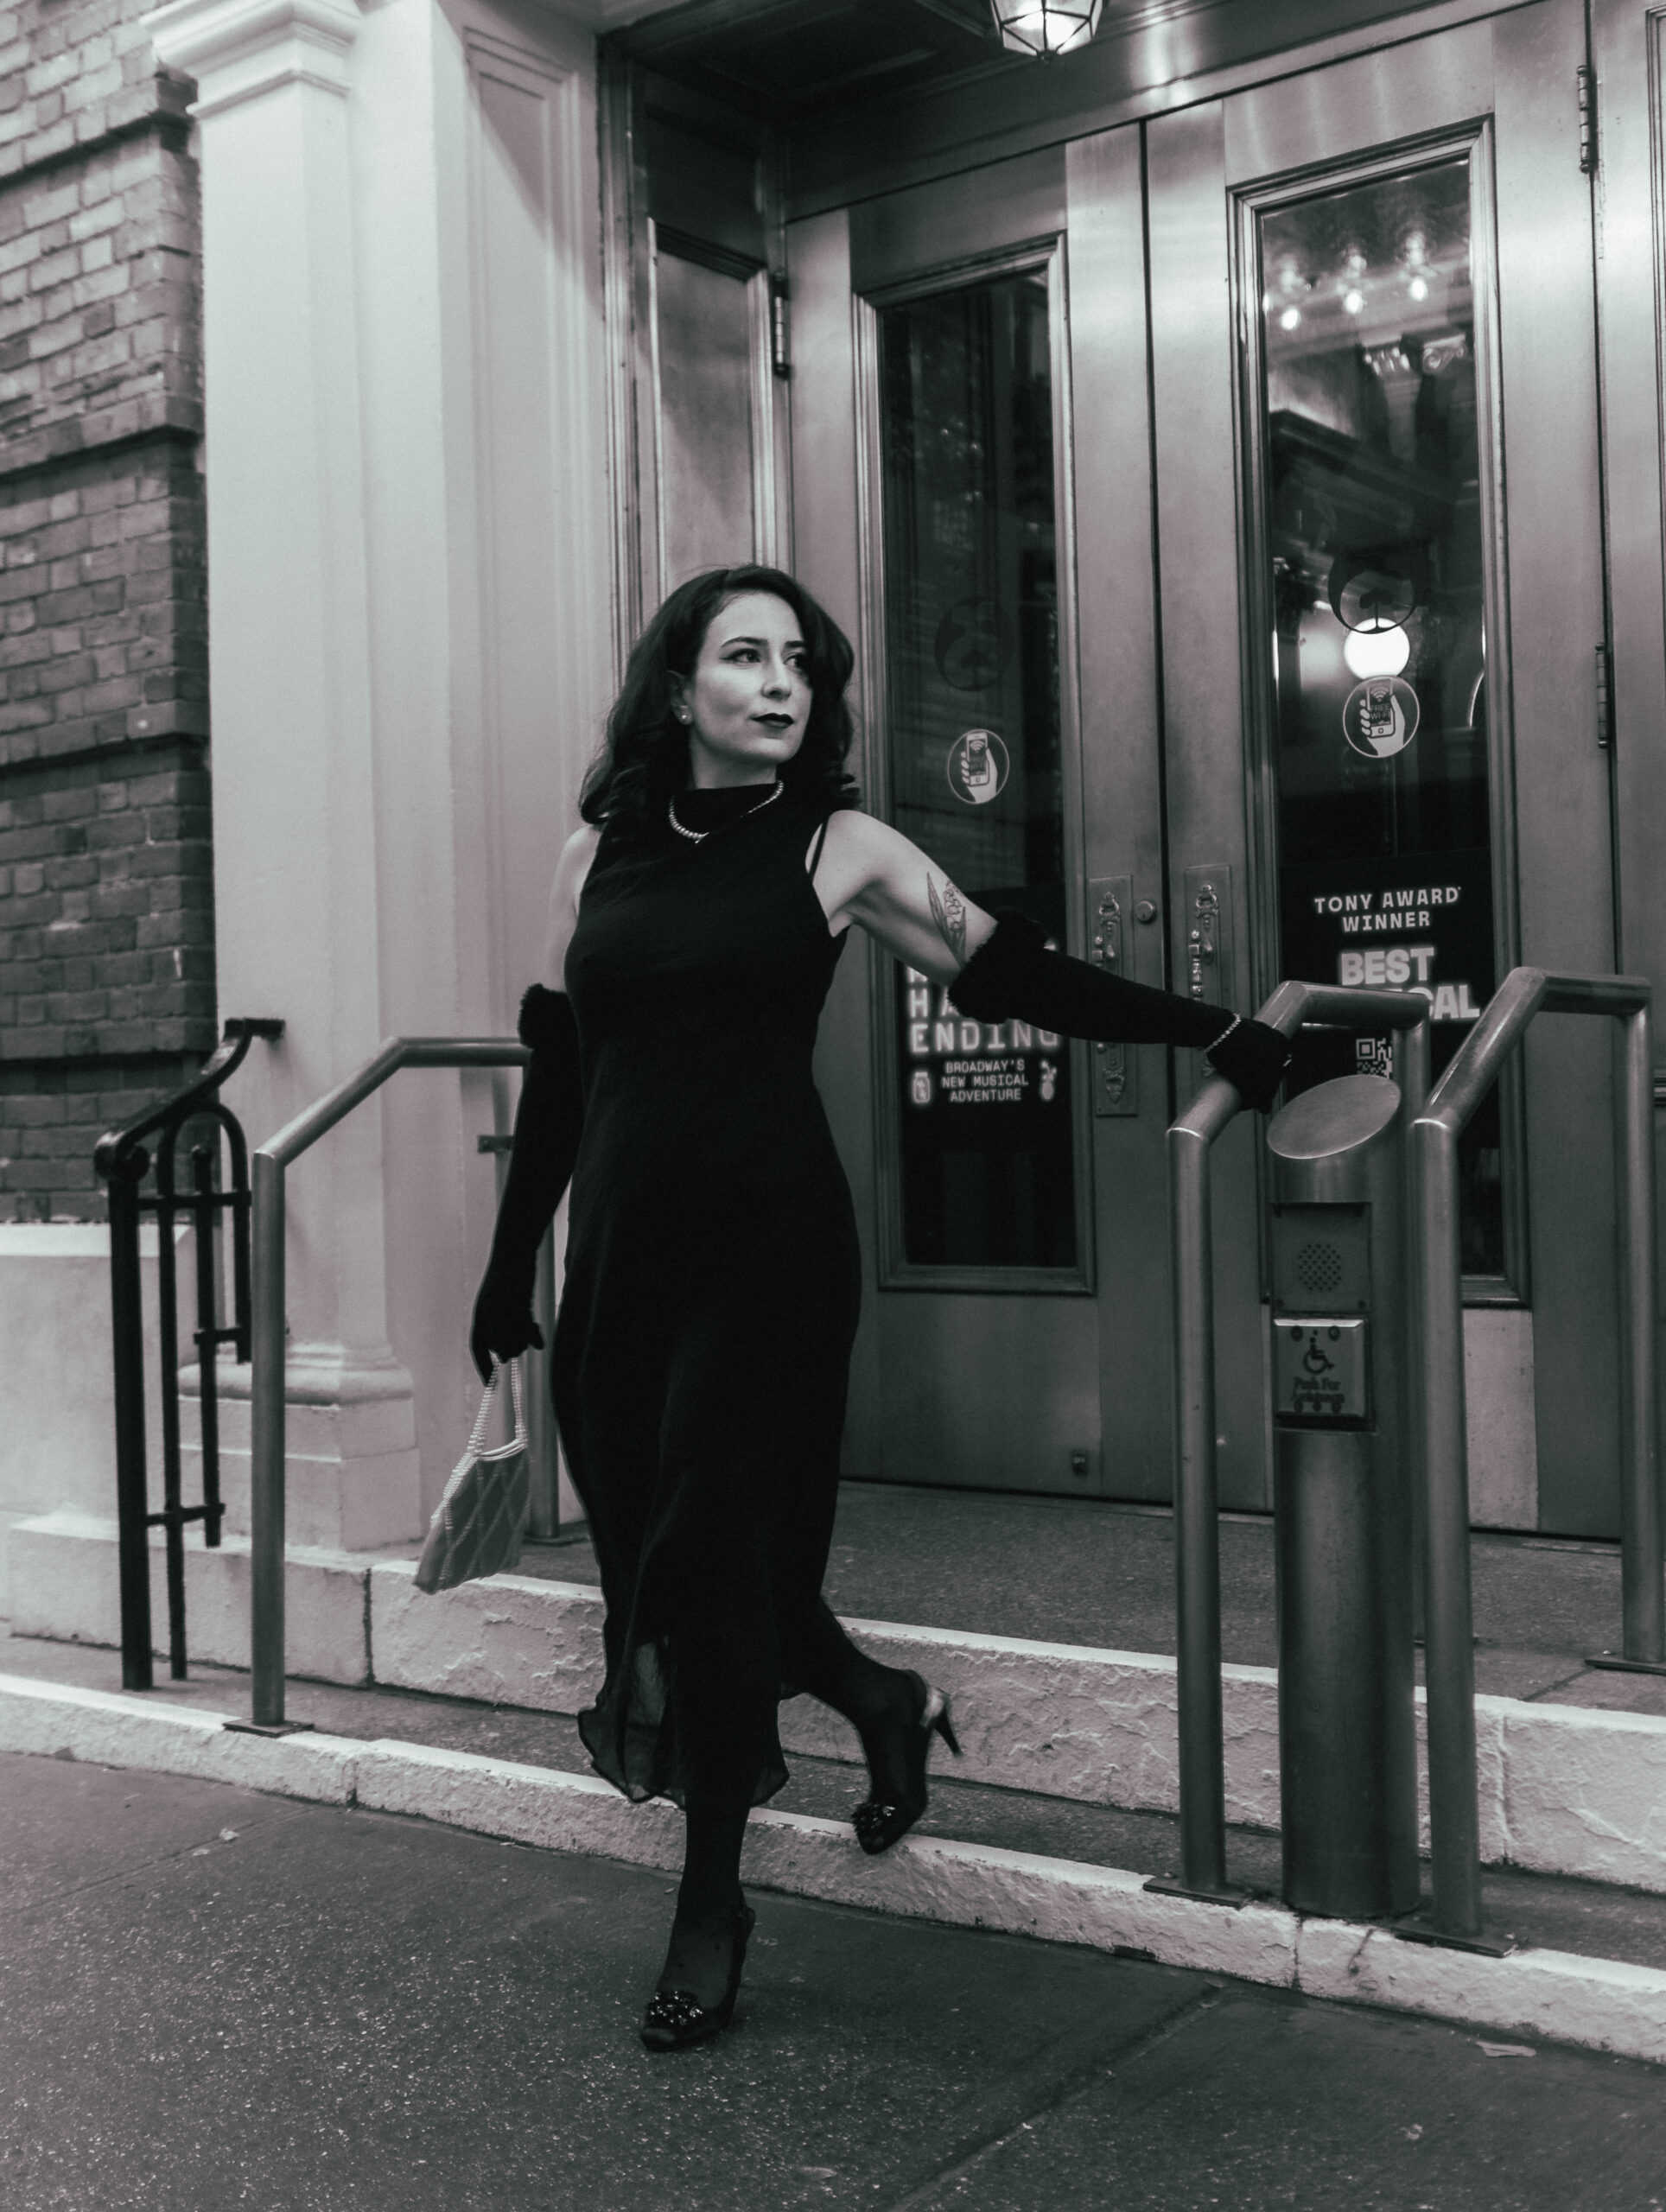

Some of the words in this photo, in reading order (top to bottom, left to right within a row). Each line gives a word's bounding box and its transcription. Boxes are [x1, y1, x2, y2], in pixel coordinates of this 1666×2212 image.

[1314, 894, 1372, 913] TONY
[1383, 887, 1459, 908] AWARD
[1343, 911, 1430, 931] WINNER
[1341, 947, 1434, 986] BEST
[946, 1059, 1026, 1073] BROADWAY'S
[942, 1077, 966, 1088] NEW
[973, 1074, 1029, 1087] MUSICAL
[951, 1089, 1021, 1103] ADVENTURE
